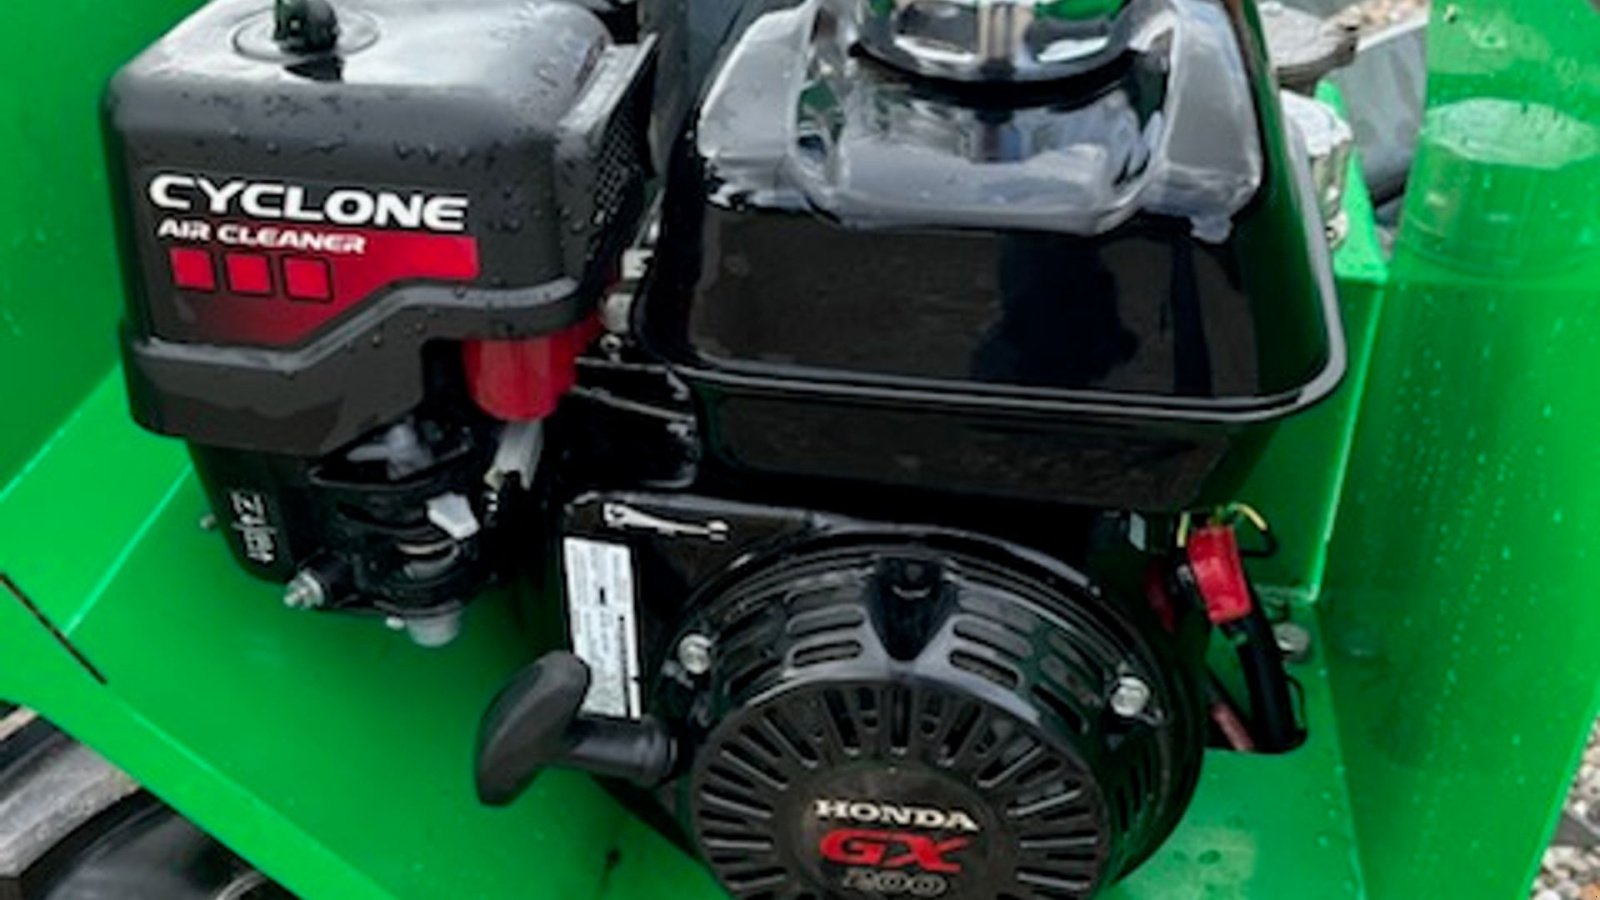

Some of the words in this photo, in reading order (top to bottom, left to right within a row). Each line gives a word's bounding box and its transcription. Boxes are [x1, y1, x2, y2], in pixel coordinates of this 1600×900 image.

[150, 175, 468, 230] CYCLONE
[158, 218, 211, 240] AIR
[217, 226, 366, 254] CLEANER
[815, 800, 979, 831] HONDA
[819, 828, 971, 873] GX
